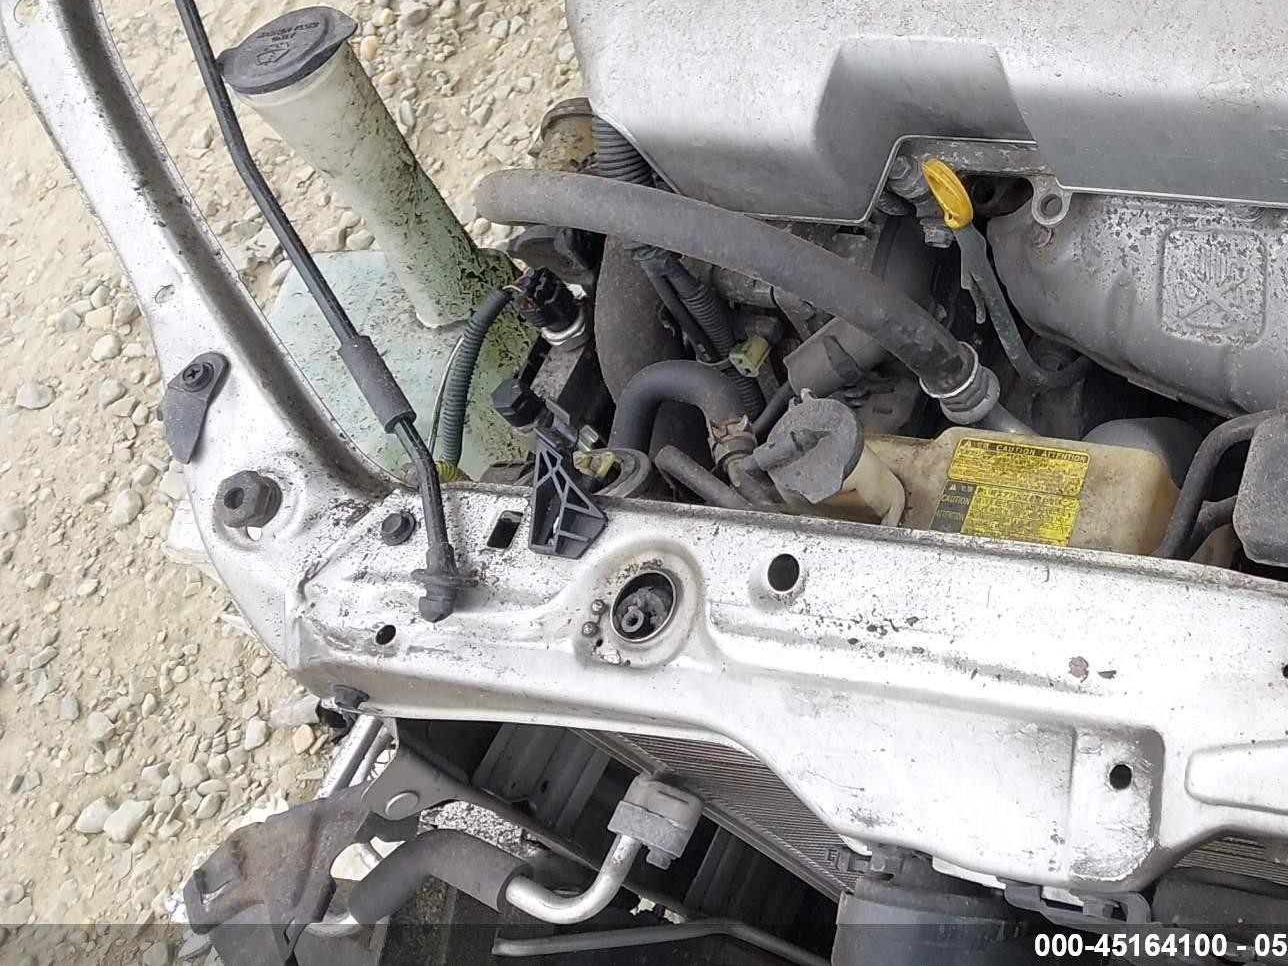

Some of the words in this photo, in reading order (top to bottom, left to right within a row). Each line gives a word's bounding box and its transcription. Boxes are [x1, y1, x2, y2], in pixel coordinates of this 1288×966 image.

[996, 444, 1036, 456] CAUTION
[1041, 450, 1087, 463] ATTENTION
[941, 495, 970, 506] CAUTION
